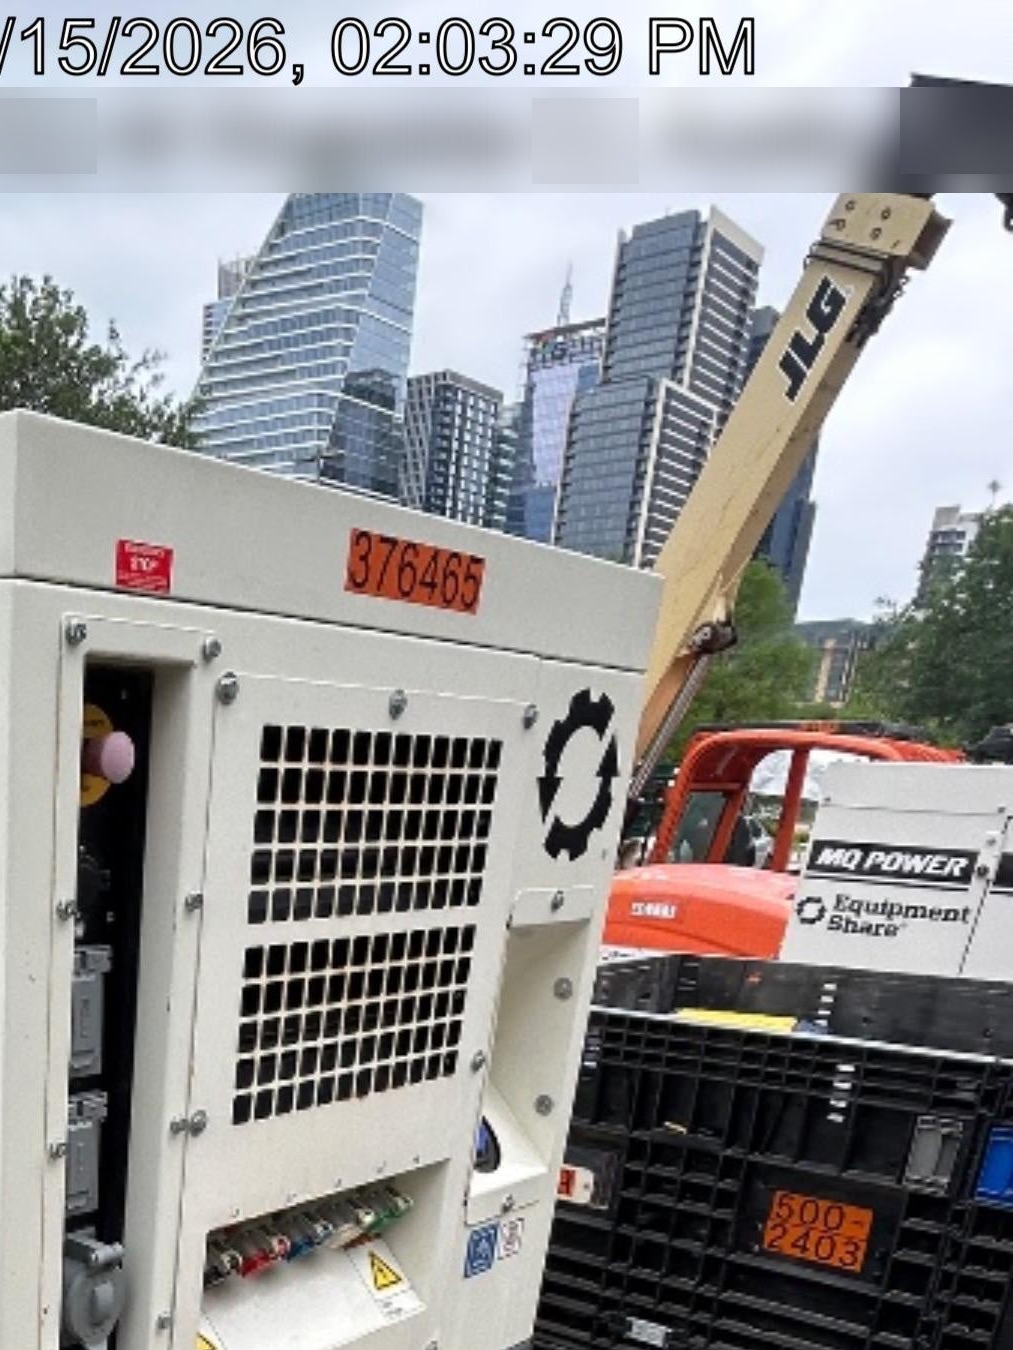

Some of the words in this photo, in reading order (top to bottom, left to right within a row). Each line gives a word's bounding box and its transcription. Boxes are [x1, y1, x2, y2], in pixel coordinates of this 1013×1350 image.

[778, 274, 847, 403] JLG
[348, 531, 485, 609] 376465
[816, 847, 864, 870] MQ
[864, 850, 969, 877] POWER
[826, 914, 901, 938] Share
[833, 893, 971, 925] Equipment
[776, 1193, 865, 1232] 500-
[767, 1223, 861, 1267] 2403
